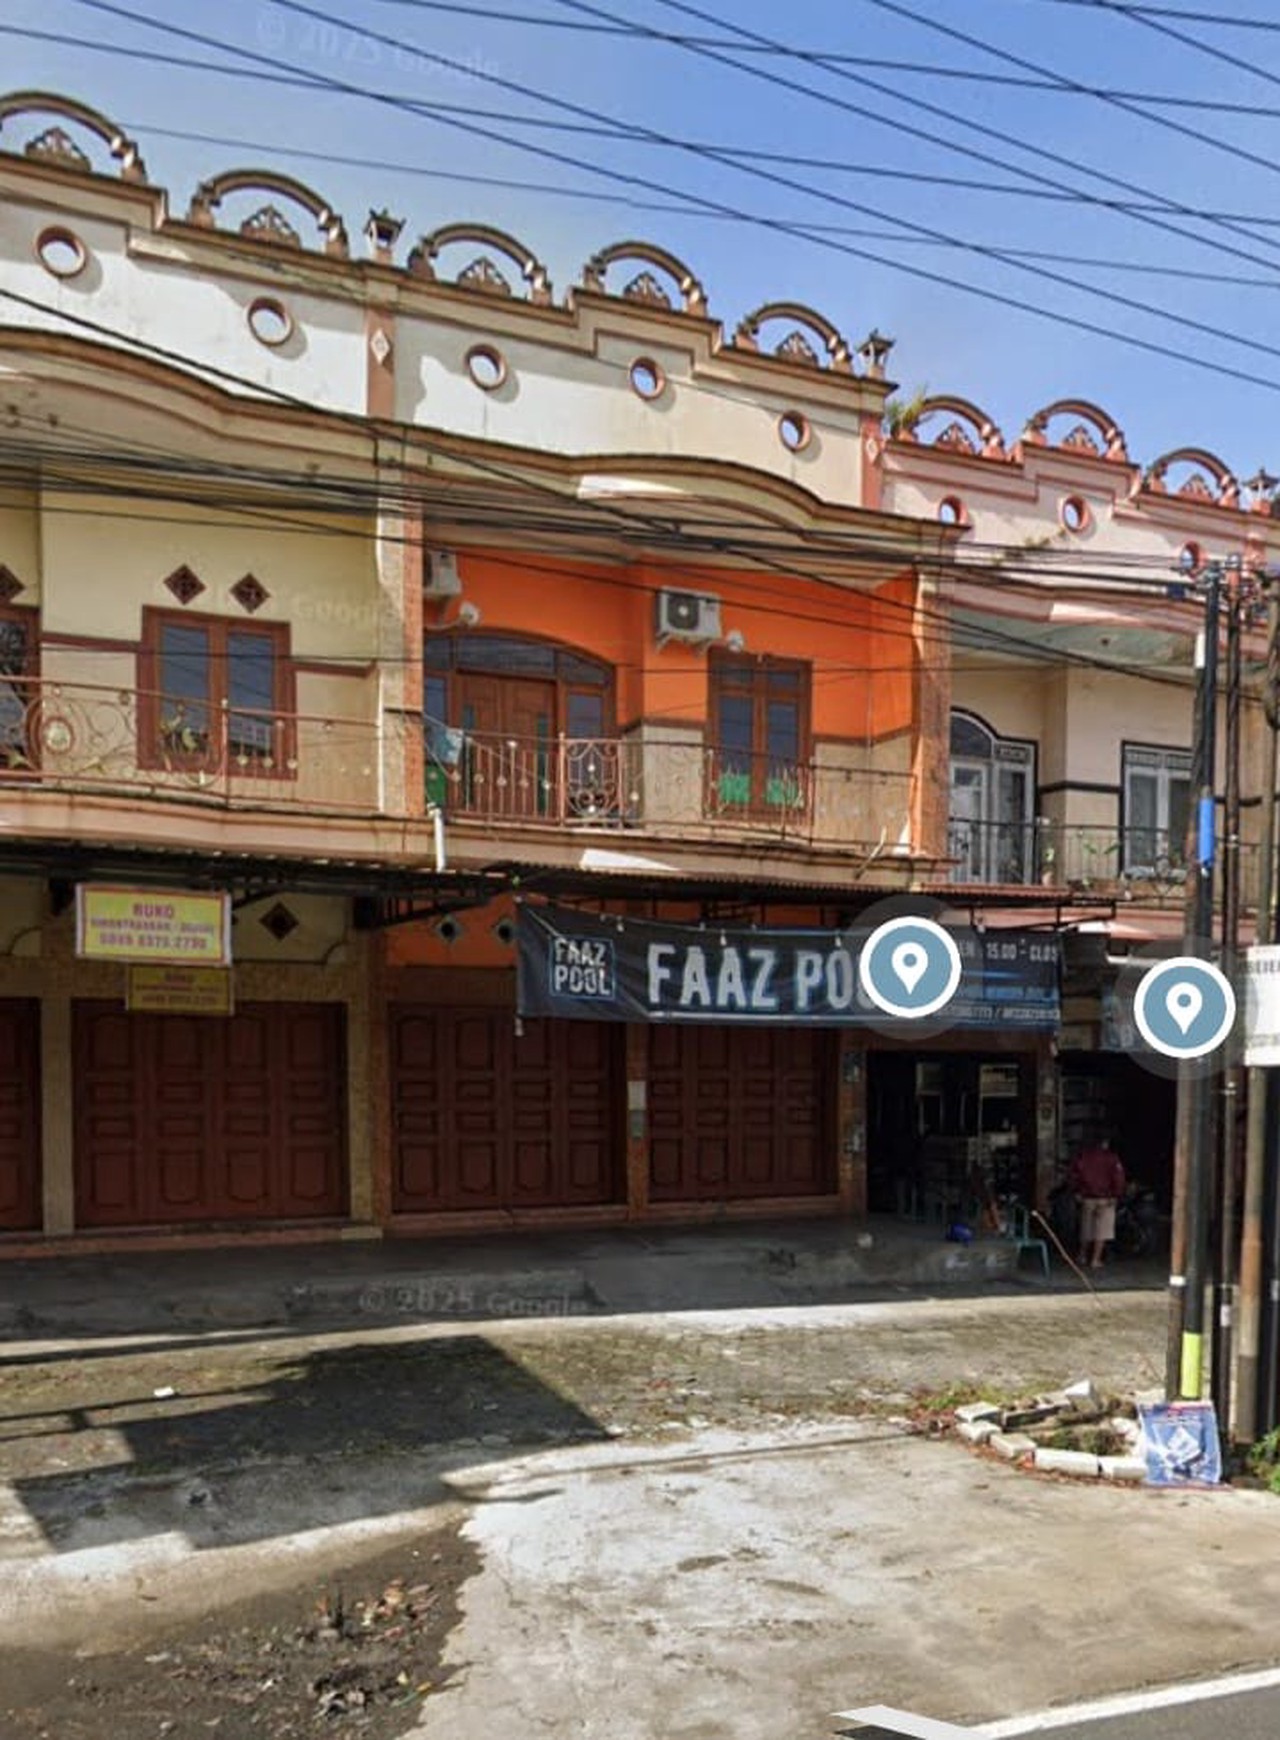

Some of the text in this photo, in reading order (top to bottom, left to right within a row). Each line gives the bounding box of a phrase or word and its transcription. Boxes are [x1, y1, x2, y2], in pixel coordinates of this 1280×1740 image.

[554, 936, 607, 966] FAAZ
[554, 965, 611, 995] POOL
[646, 942, 779, 1010] FAAZ
